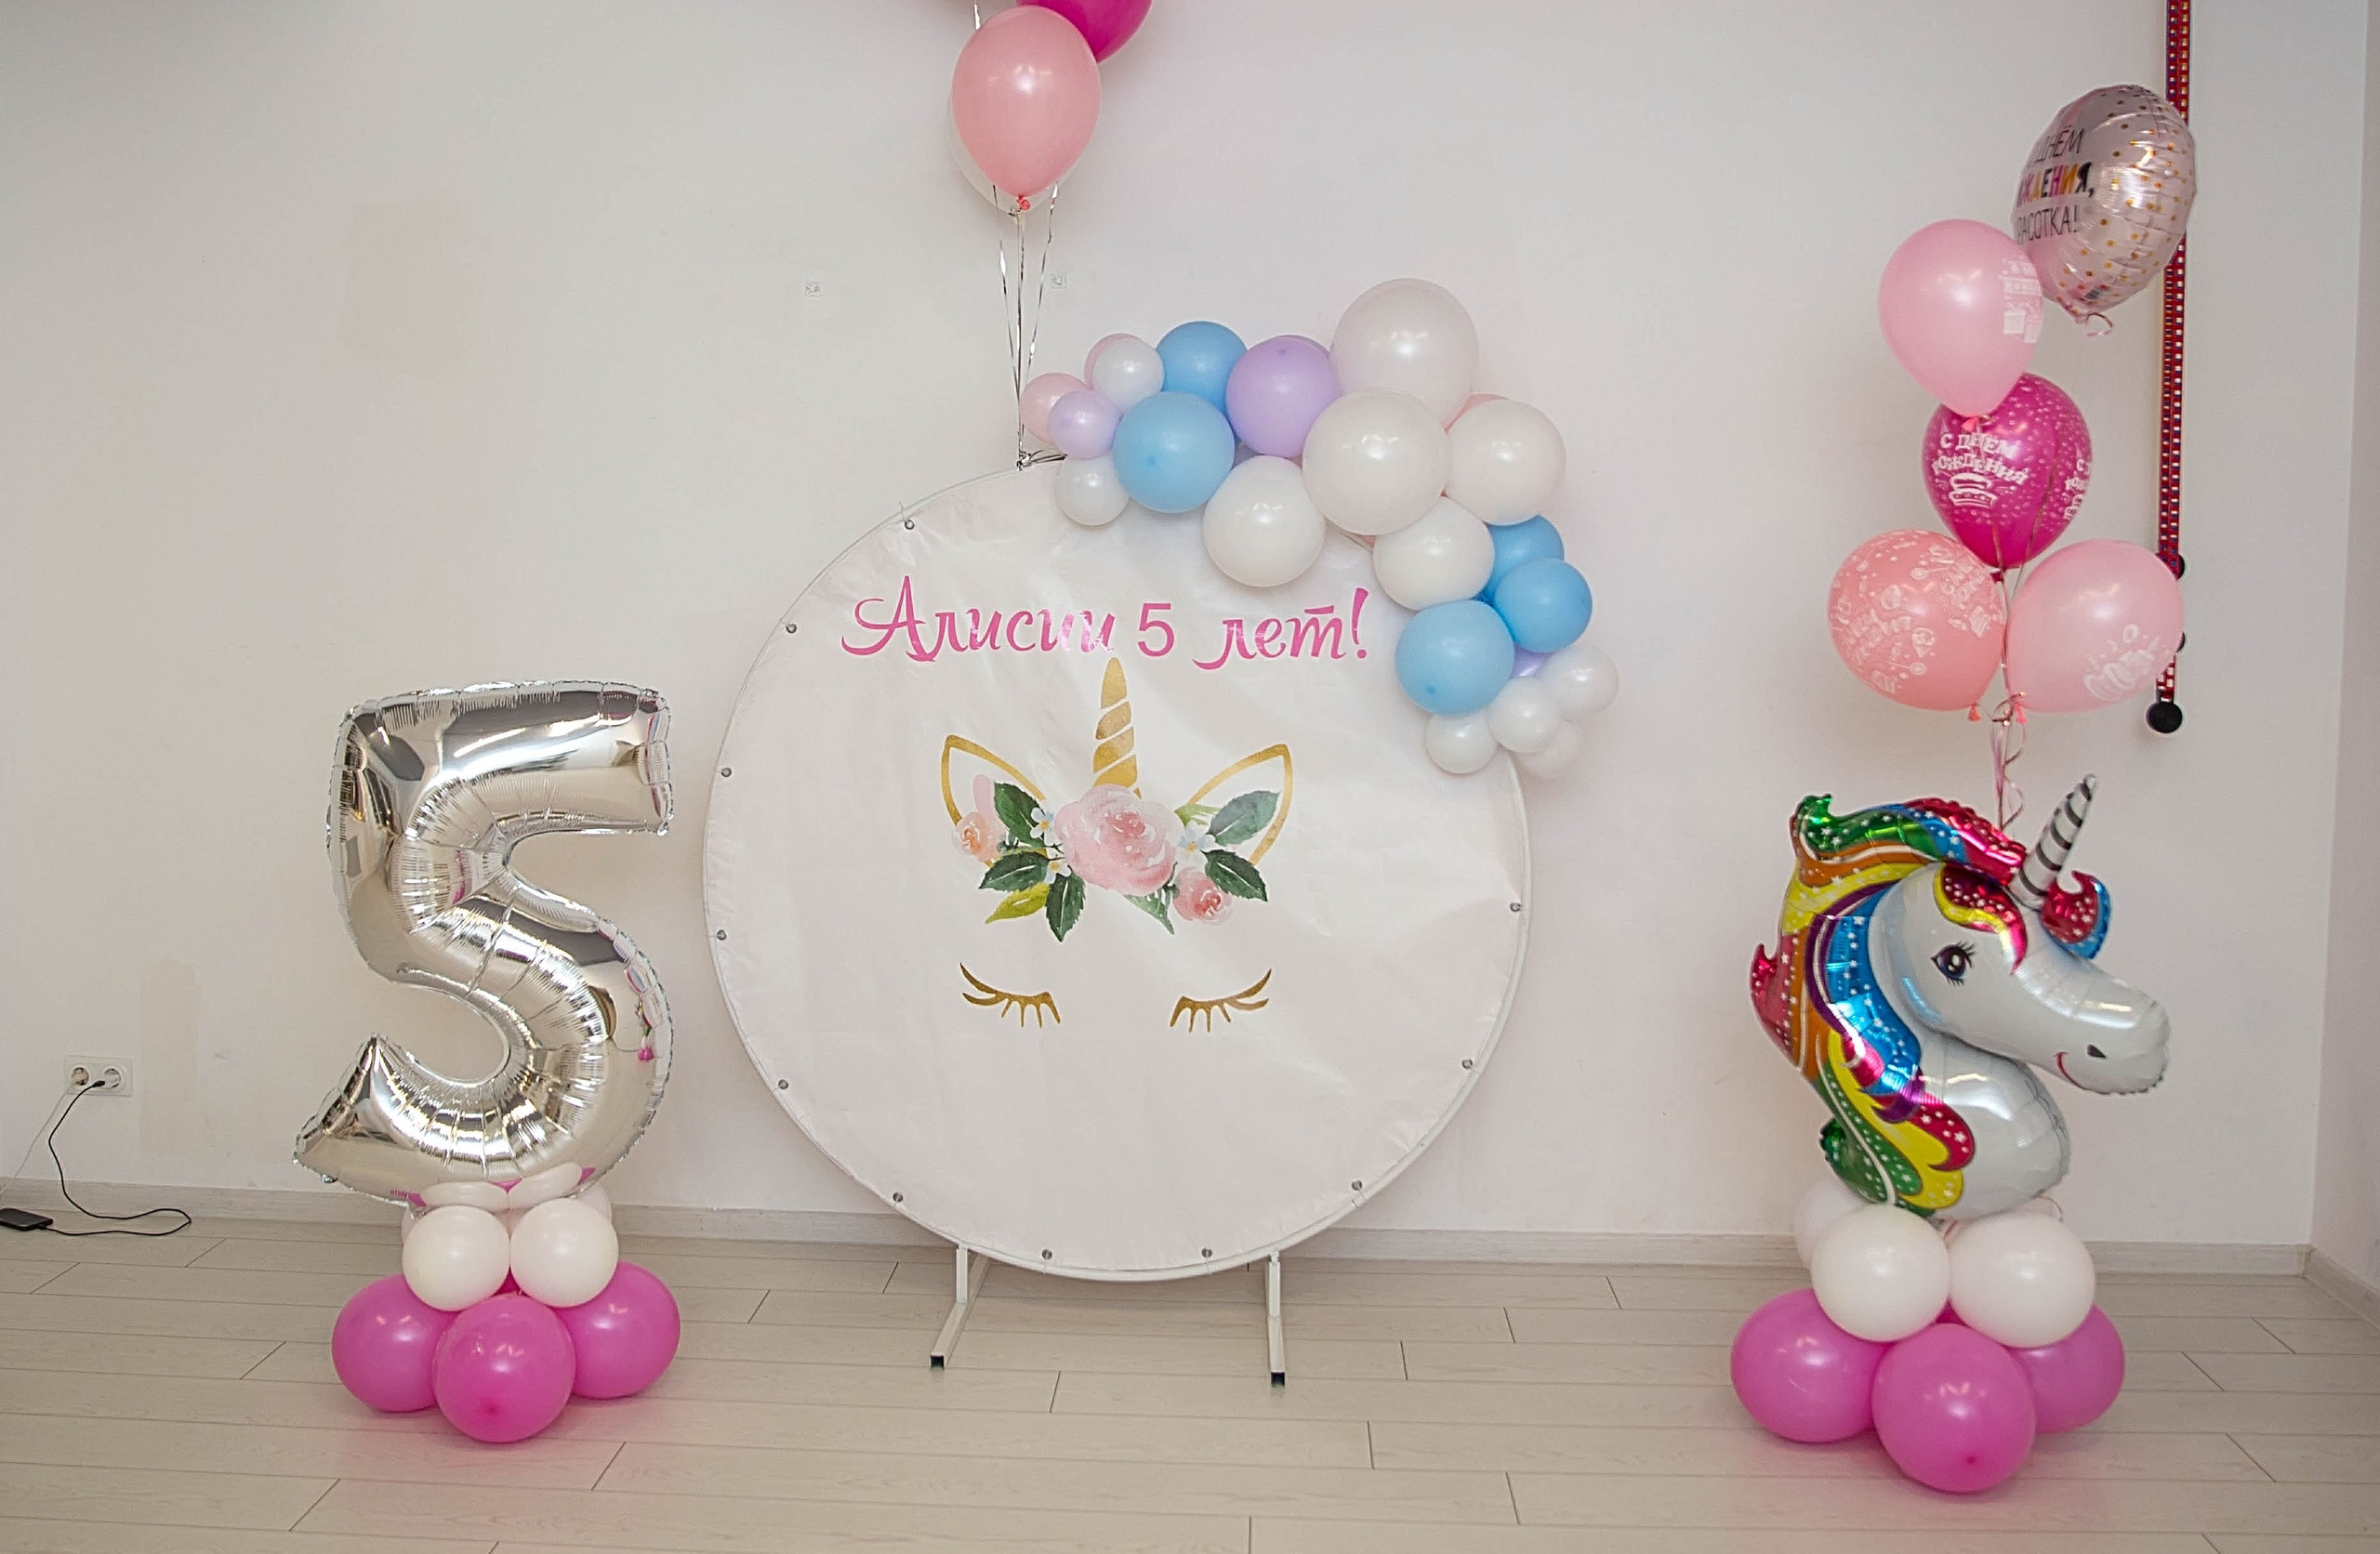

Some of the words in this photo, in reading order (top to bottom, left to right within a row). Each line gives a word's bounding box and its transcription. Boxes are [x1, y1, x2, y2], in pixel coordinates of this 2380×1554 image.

[840, 574, 1117, 662] Алисии
[1137, 602, 1175, 657] 5
[1192, 587, 1369, 670] лет!
